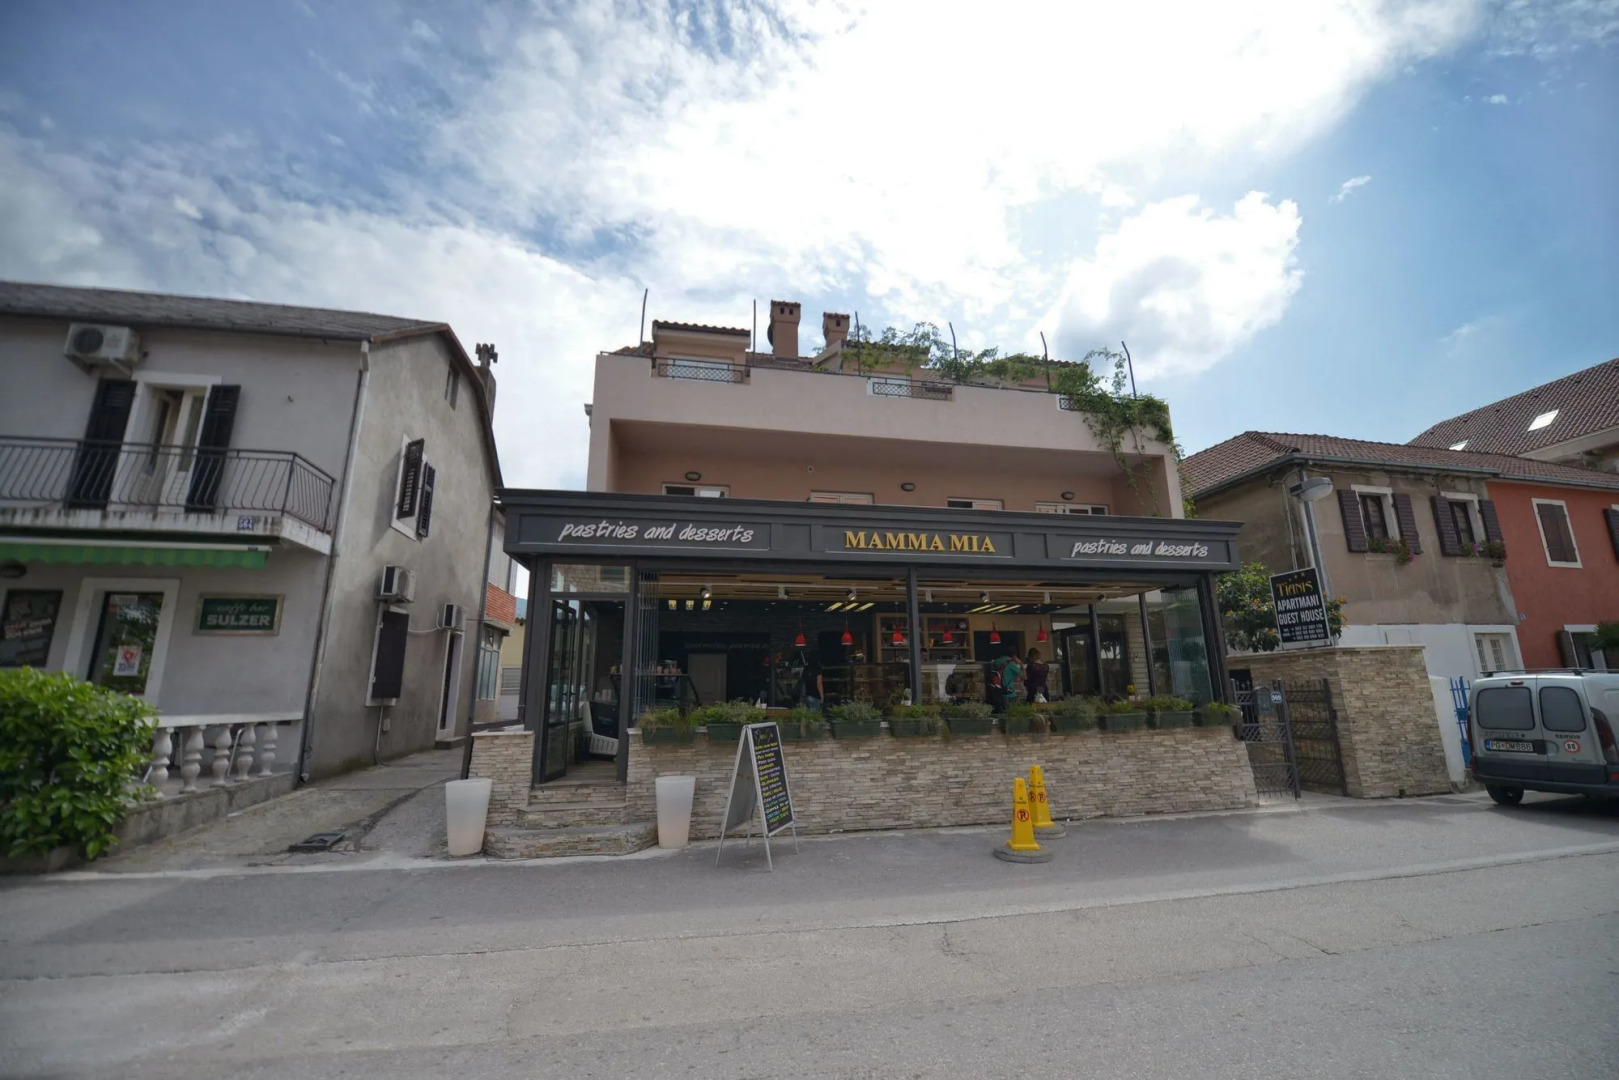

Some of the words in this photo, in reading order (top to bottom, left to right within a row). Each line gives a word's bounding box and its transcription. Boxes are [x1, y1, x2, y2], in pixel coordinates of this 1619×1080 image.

[557, 520, 639, 542] pastries
[643, 522, 677, 540] and
[678, 523, 755, 543] desserts
[844, 530, 945, 551] MAMMA
[949, 534, 996, 553] MIA
[1070, 538, 1128, 558] pastries
[1130, 540, 1154, 555] and
[1154, 541, 1209, 557] desserts
[1277, 594, 1320, 612] APARTMANI
[207, 614, 271, 626] SULZER
[1278, 611, 1300, 626] GUEST
[1300, 608, 1325, 623] HOUSE
